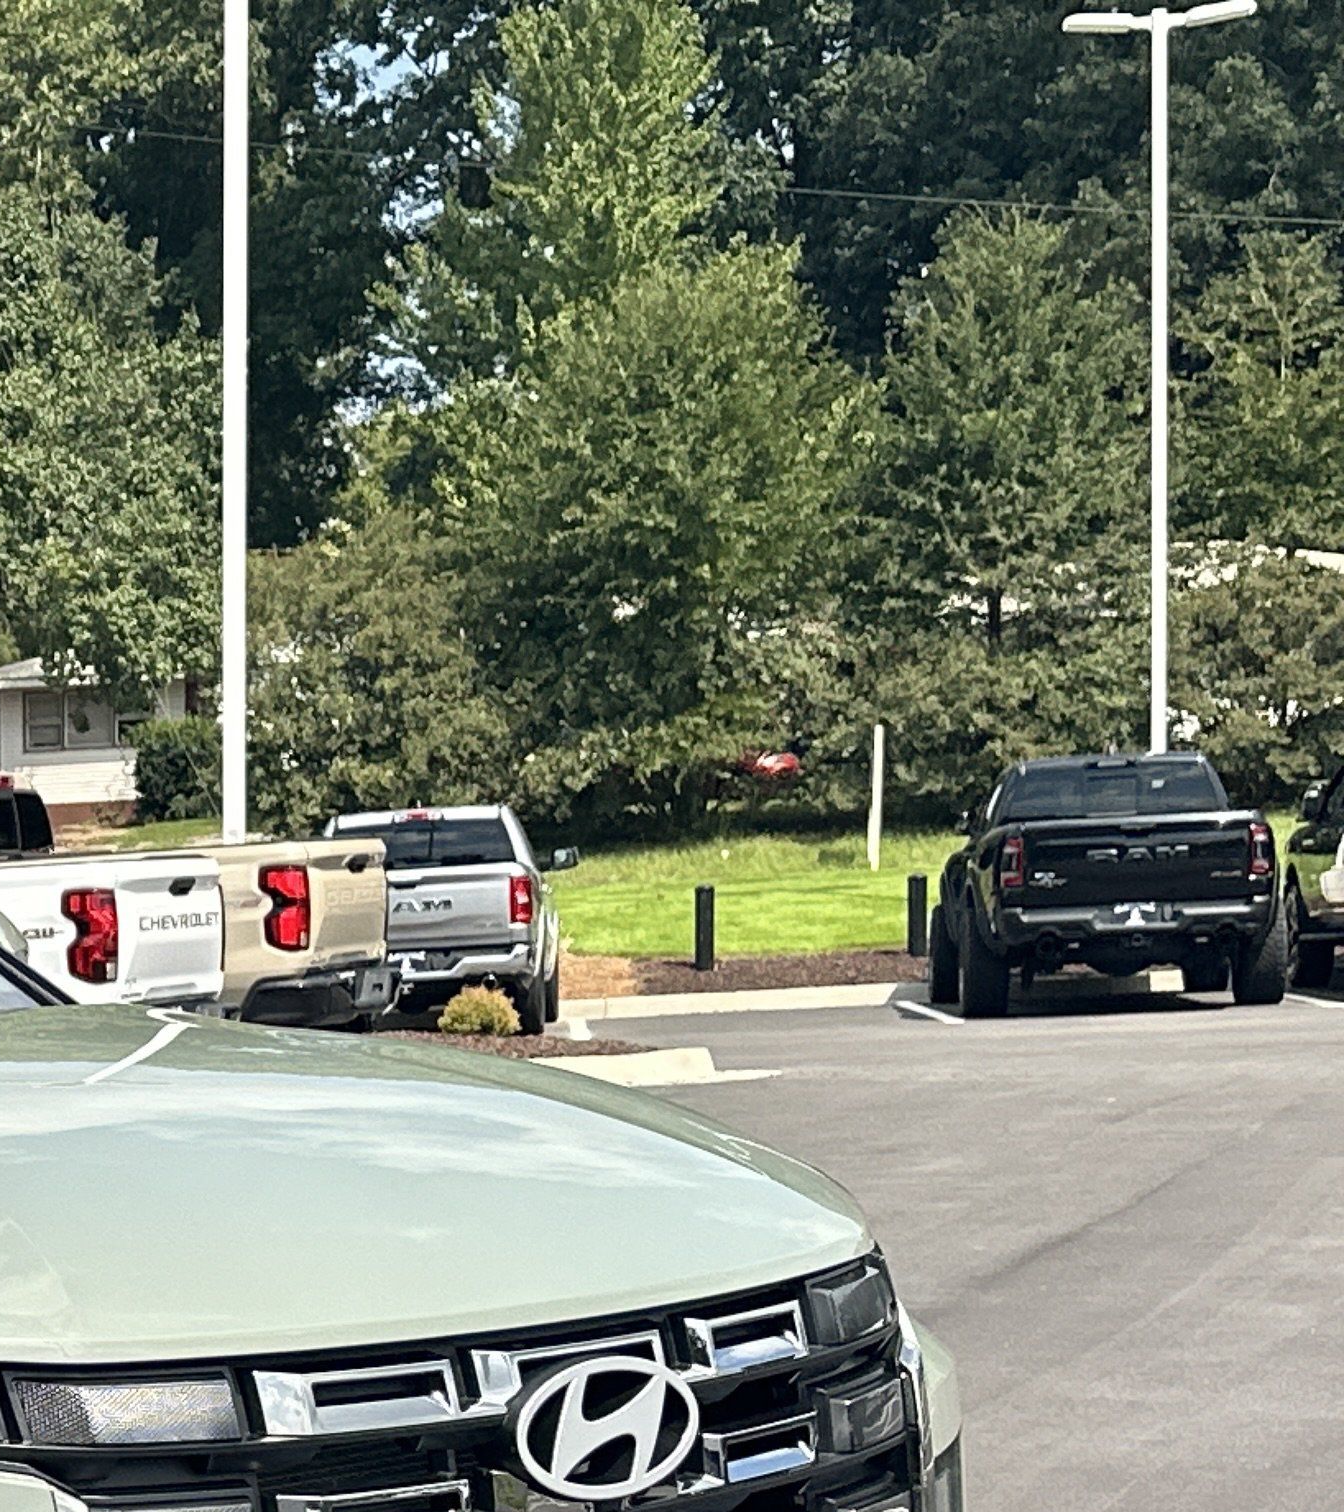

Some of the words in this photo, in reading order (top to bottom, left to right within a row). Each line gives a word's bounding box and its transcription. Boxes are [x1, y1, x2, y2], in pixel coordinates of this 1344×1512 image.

[1086, 844, 1190, 864] RAM
[392, 898, 453, 914] AM
[138, 911, 220, 932] CHEVROLET
